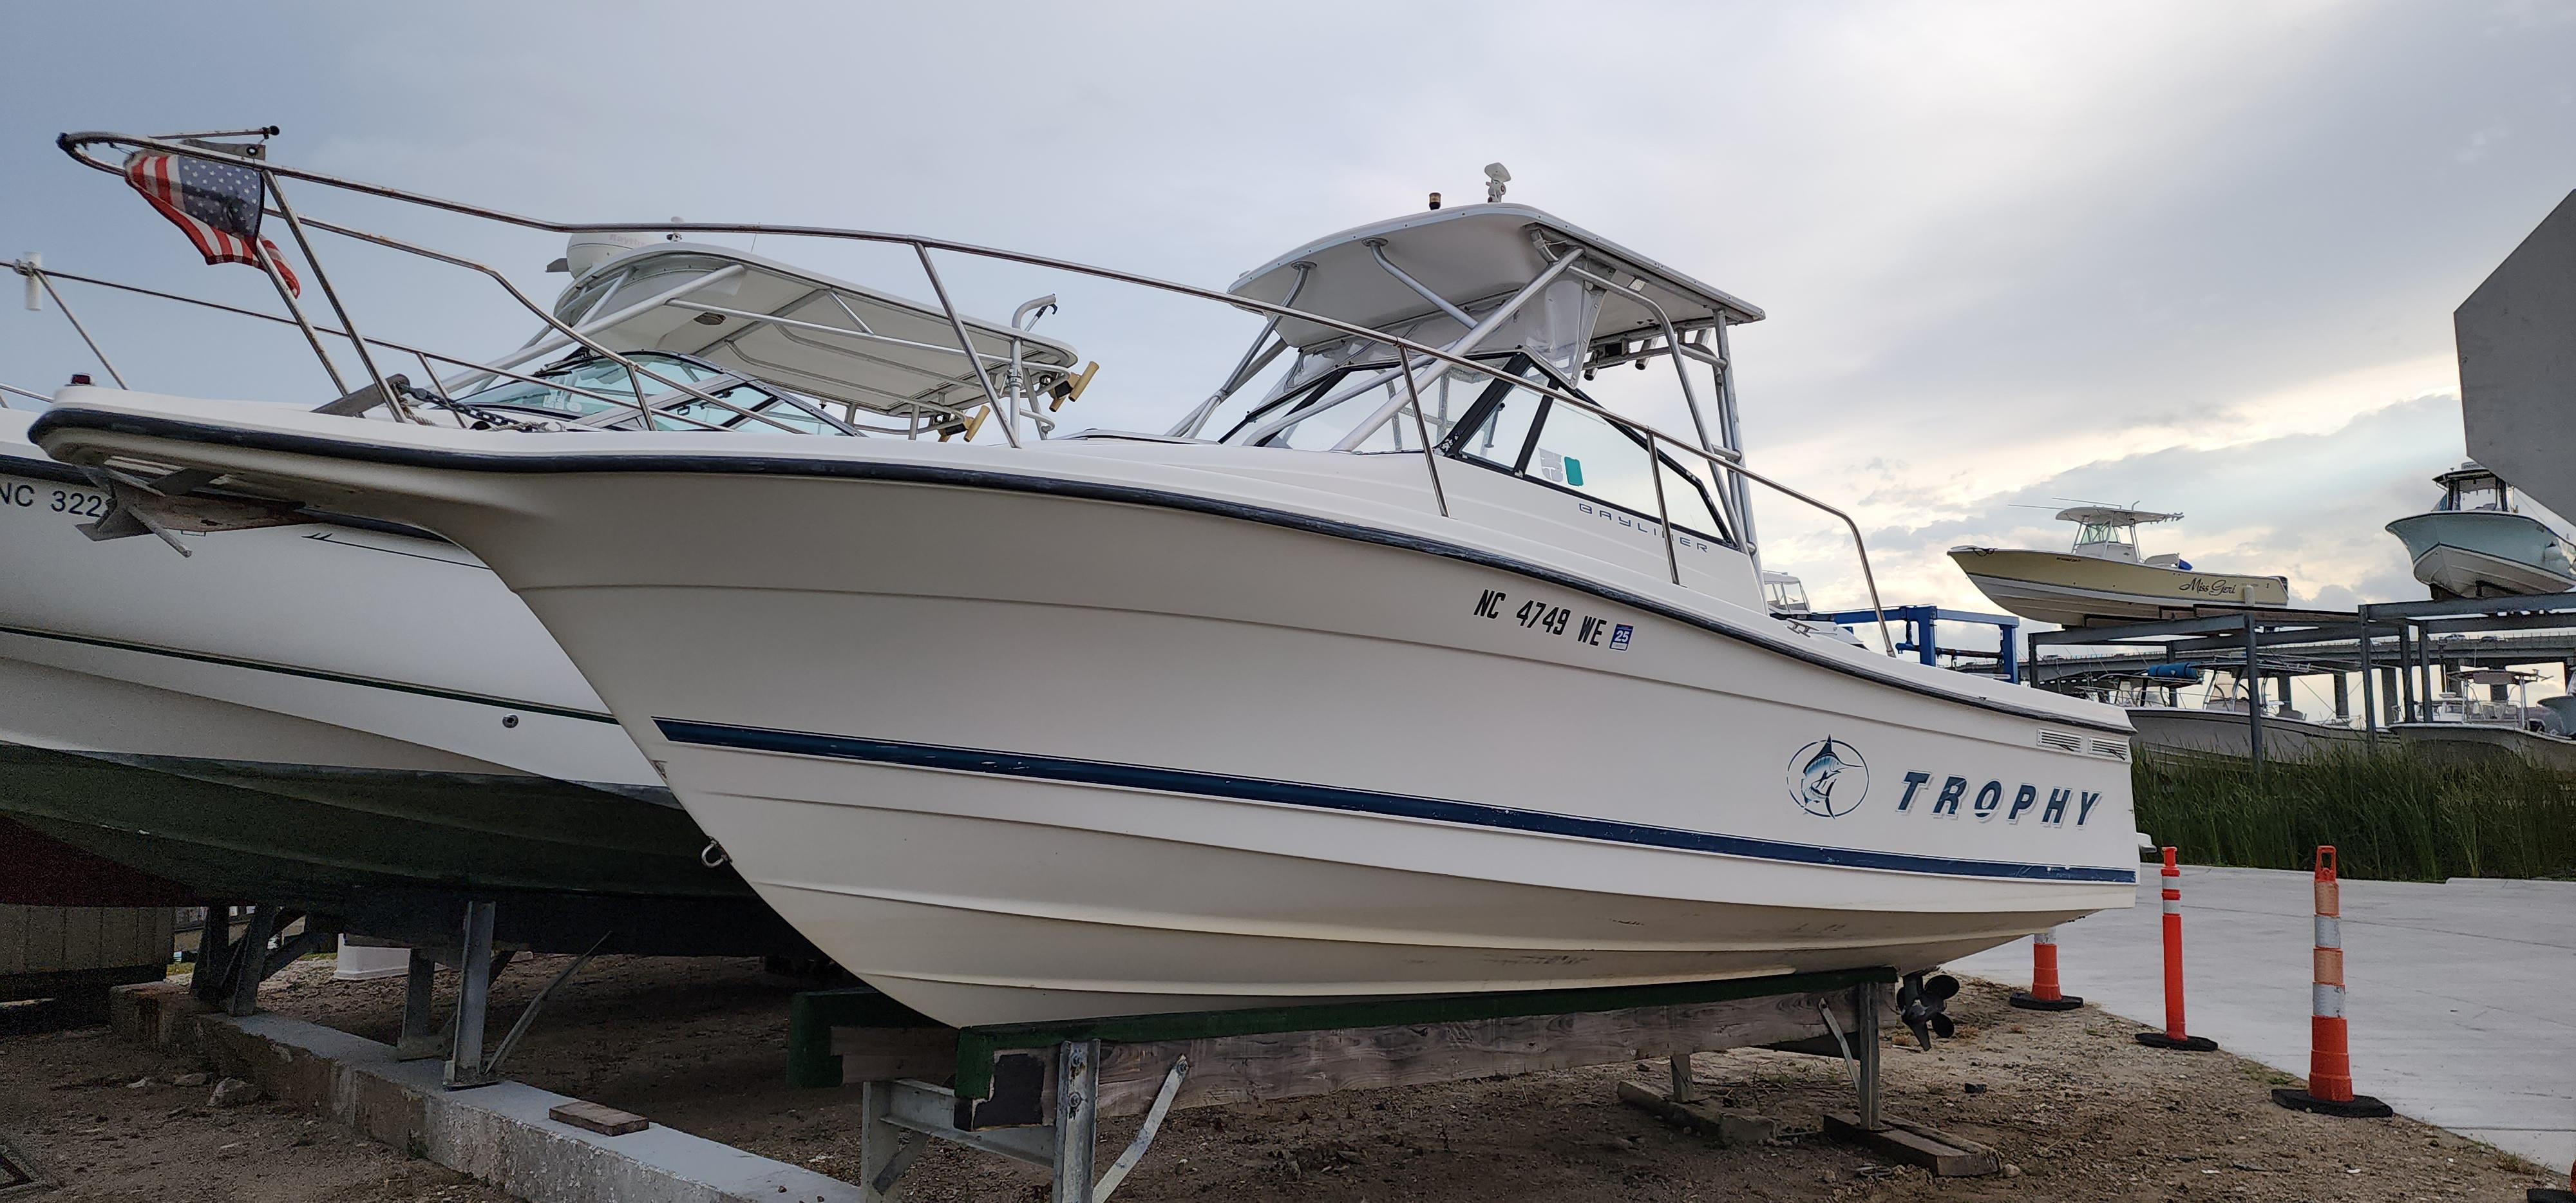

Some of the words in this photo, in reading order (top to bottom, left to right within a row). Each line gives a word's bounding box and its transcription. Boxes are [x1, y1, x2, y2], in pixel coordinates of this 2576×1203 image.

[0, 482, 35, 507] NC
[51, 490, 104, 517] 322
[2179, 577, 2209, 594] Miss
[2209, 580, 2237, 596] Geri
[1473, 589, 1506, 619] NC
[1516, 600, 1571, 636] 4749
[1578, 615, 1607, 646] WE
[1614, 630, 1629, 643] 25
[1895, 770, 2102, 829] TROPHY
